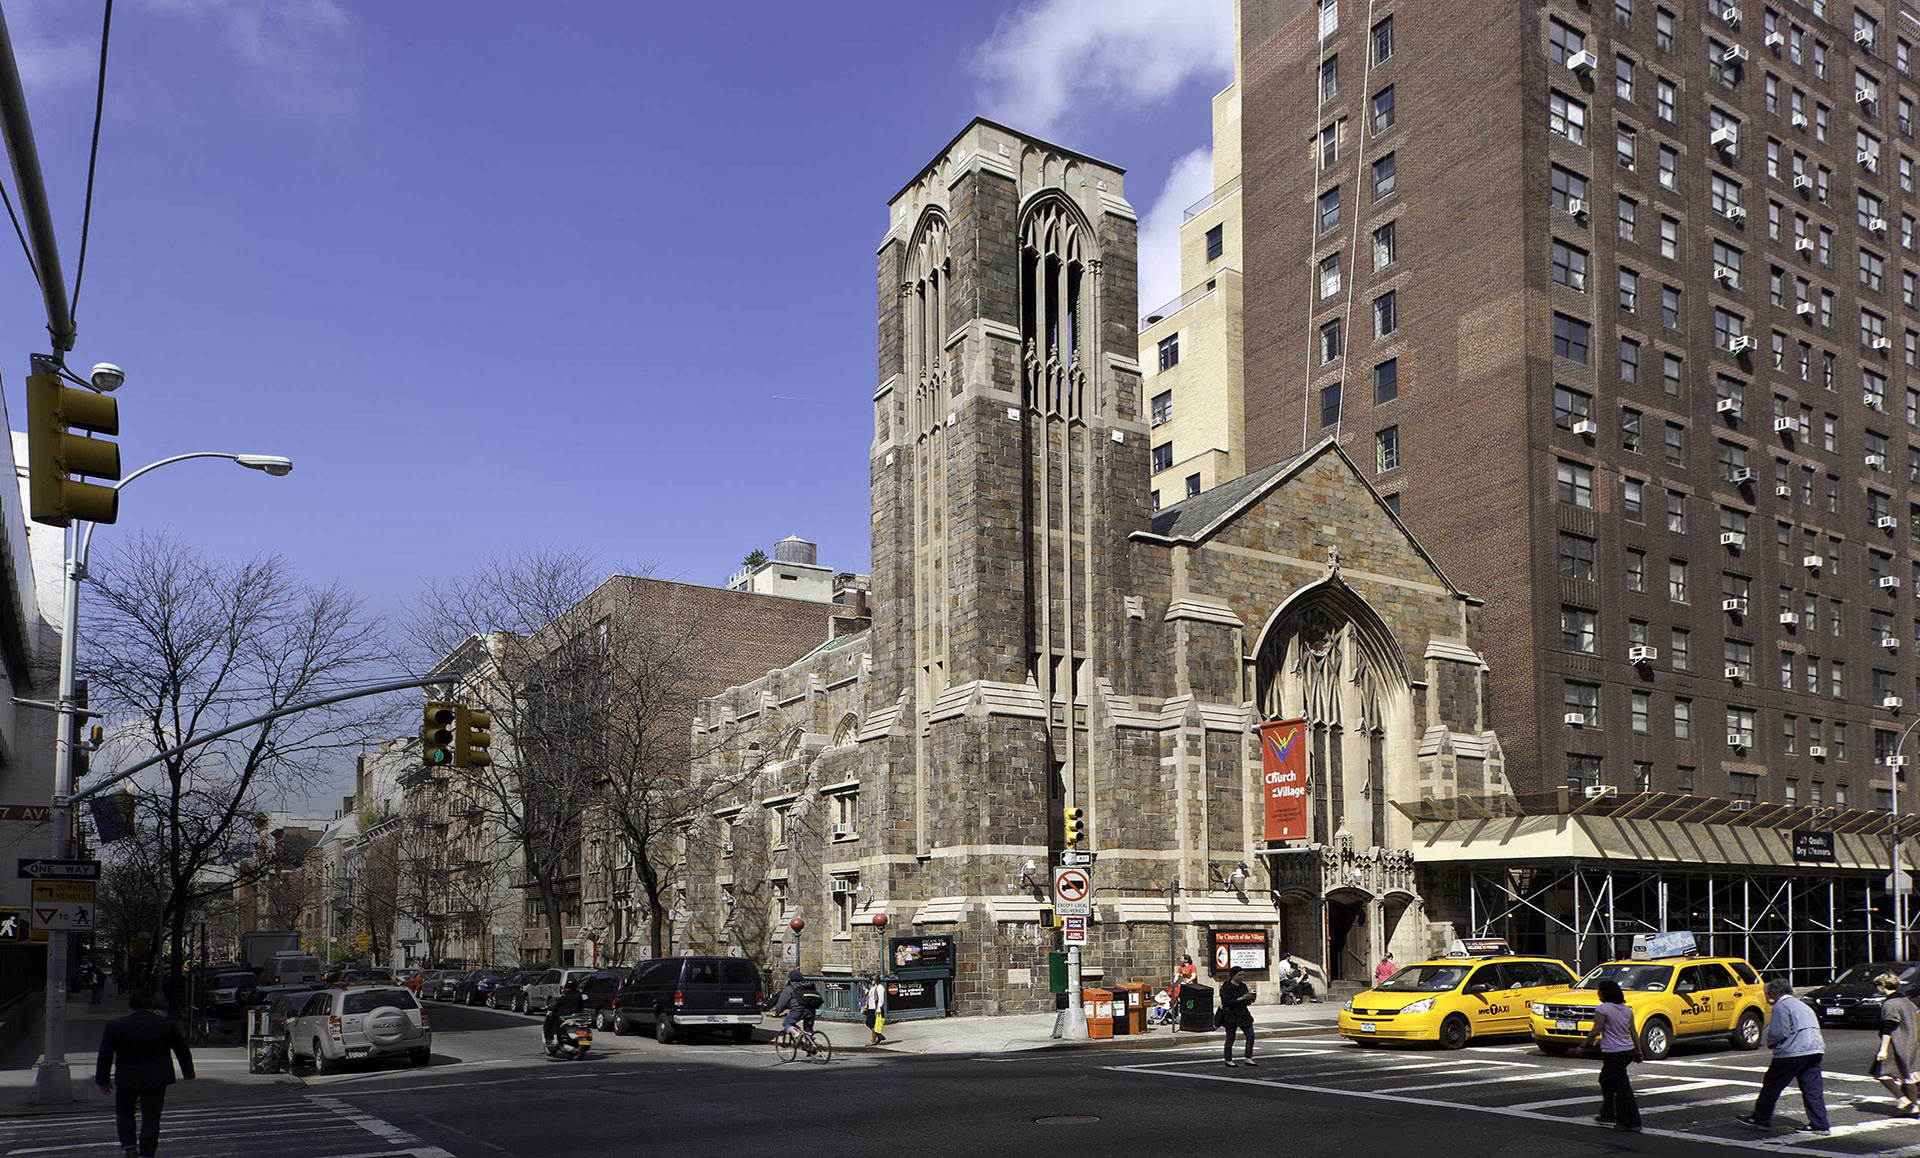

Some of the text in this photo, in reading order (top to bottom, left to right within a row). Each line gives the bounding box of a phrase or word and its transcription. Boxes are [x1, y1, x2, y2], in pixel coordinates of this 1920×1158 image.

[1265, 770, 1297, 784] Church
[1278, 785, 1305, 798] Village
[1796, 846, 1831, 857] Dry Cleaners
[31, 865, 90, 874] ONE WAY
[56, 884, 93, 892] TURNING
[1251, 933, 1265, 941] Village
[1131, 994, 1137, 1003] L
[372, 1021, 408, 1030] SUZUKI
